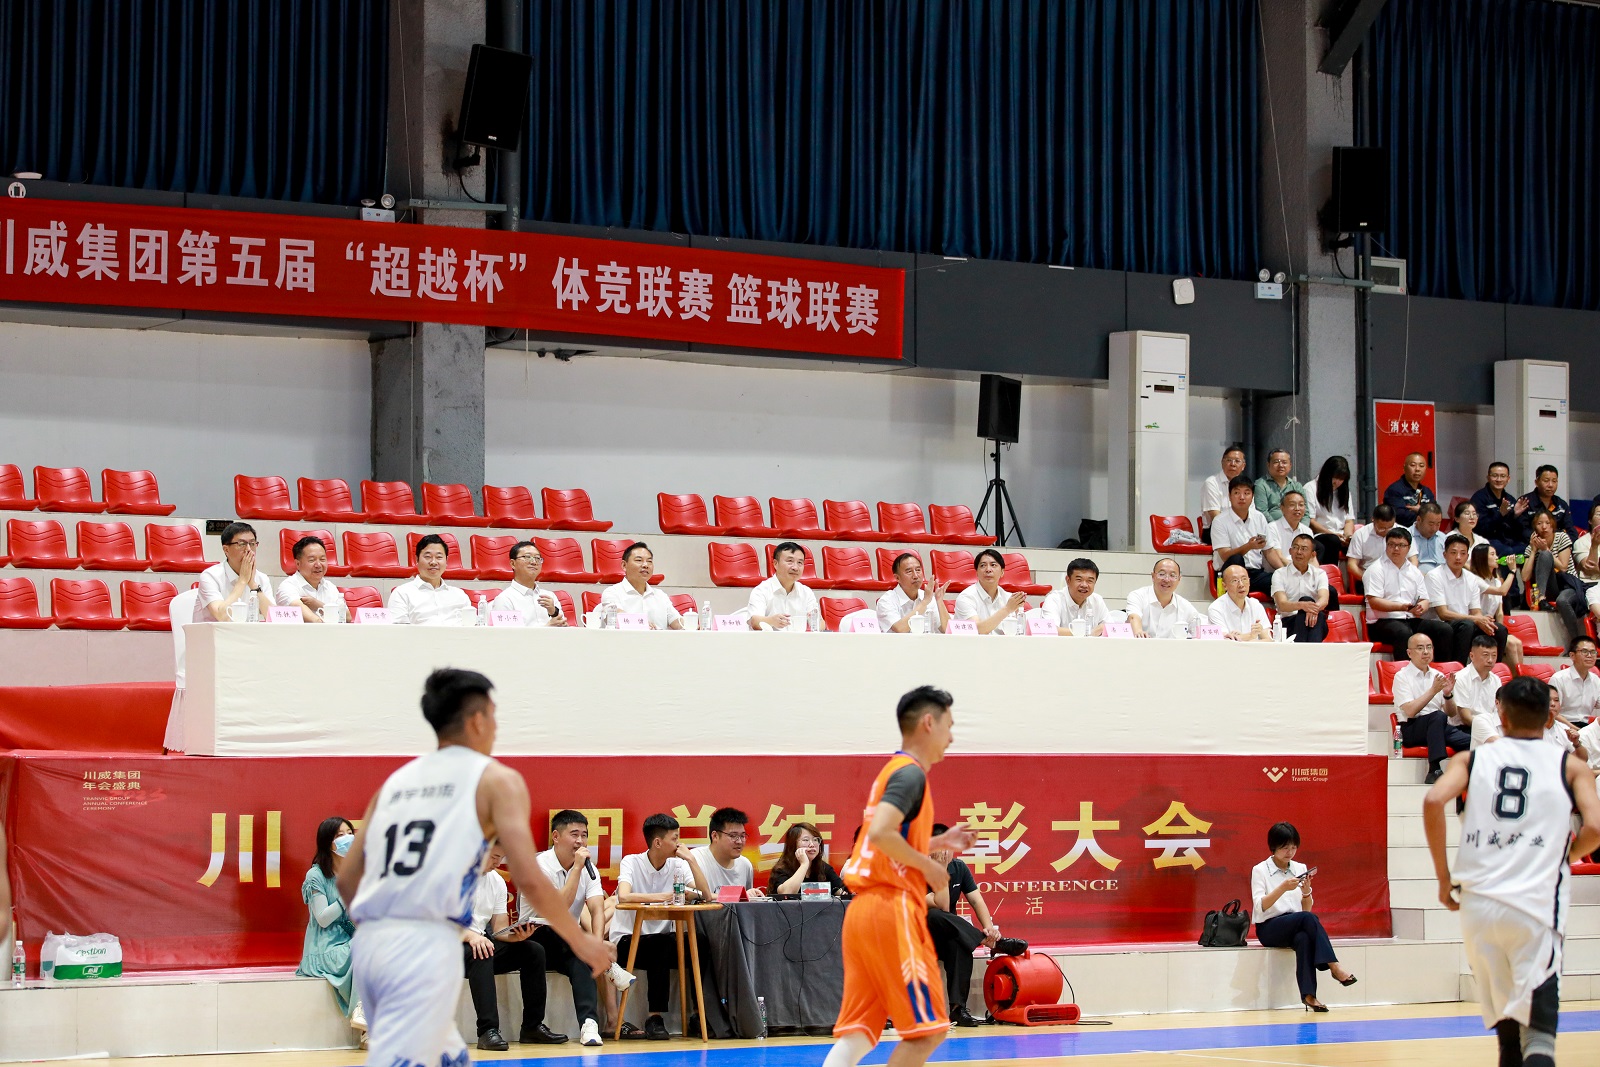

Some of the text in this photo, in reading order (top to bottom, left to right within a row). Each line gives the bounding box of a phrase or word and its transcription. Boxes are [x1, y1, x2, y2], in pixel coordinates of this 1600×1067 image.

[552, 257, 713, 322] 体竞联赛
[727, 273, 880, 336] 篮球联赛
[1391, 420, 1420, 434] 消火栓
[83, 771, 141, 779] 川威集团
[1291, 768, 1328, 776] 川威集团
[83, 782, 141, 790] 年会盛典
[1492, 765, 1531, 821] 8
[380, 820, 436, 879] 13
[975, 879, 1119, 893] ONFERENCE
[1025, 896, 1044, 915] 活
